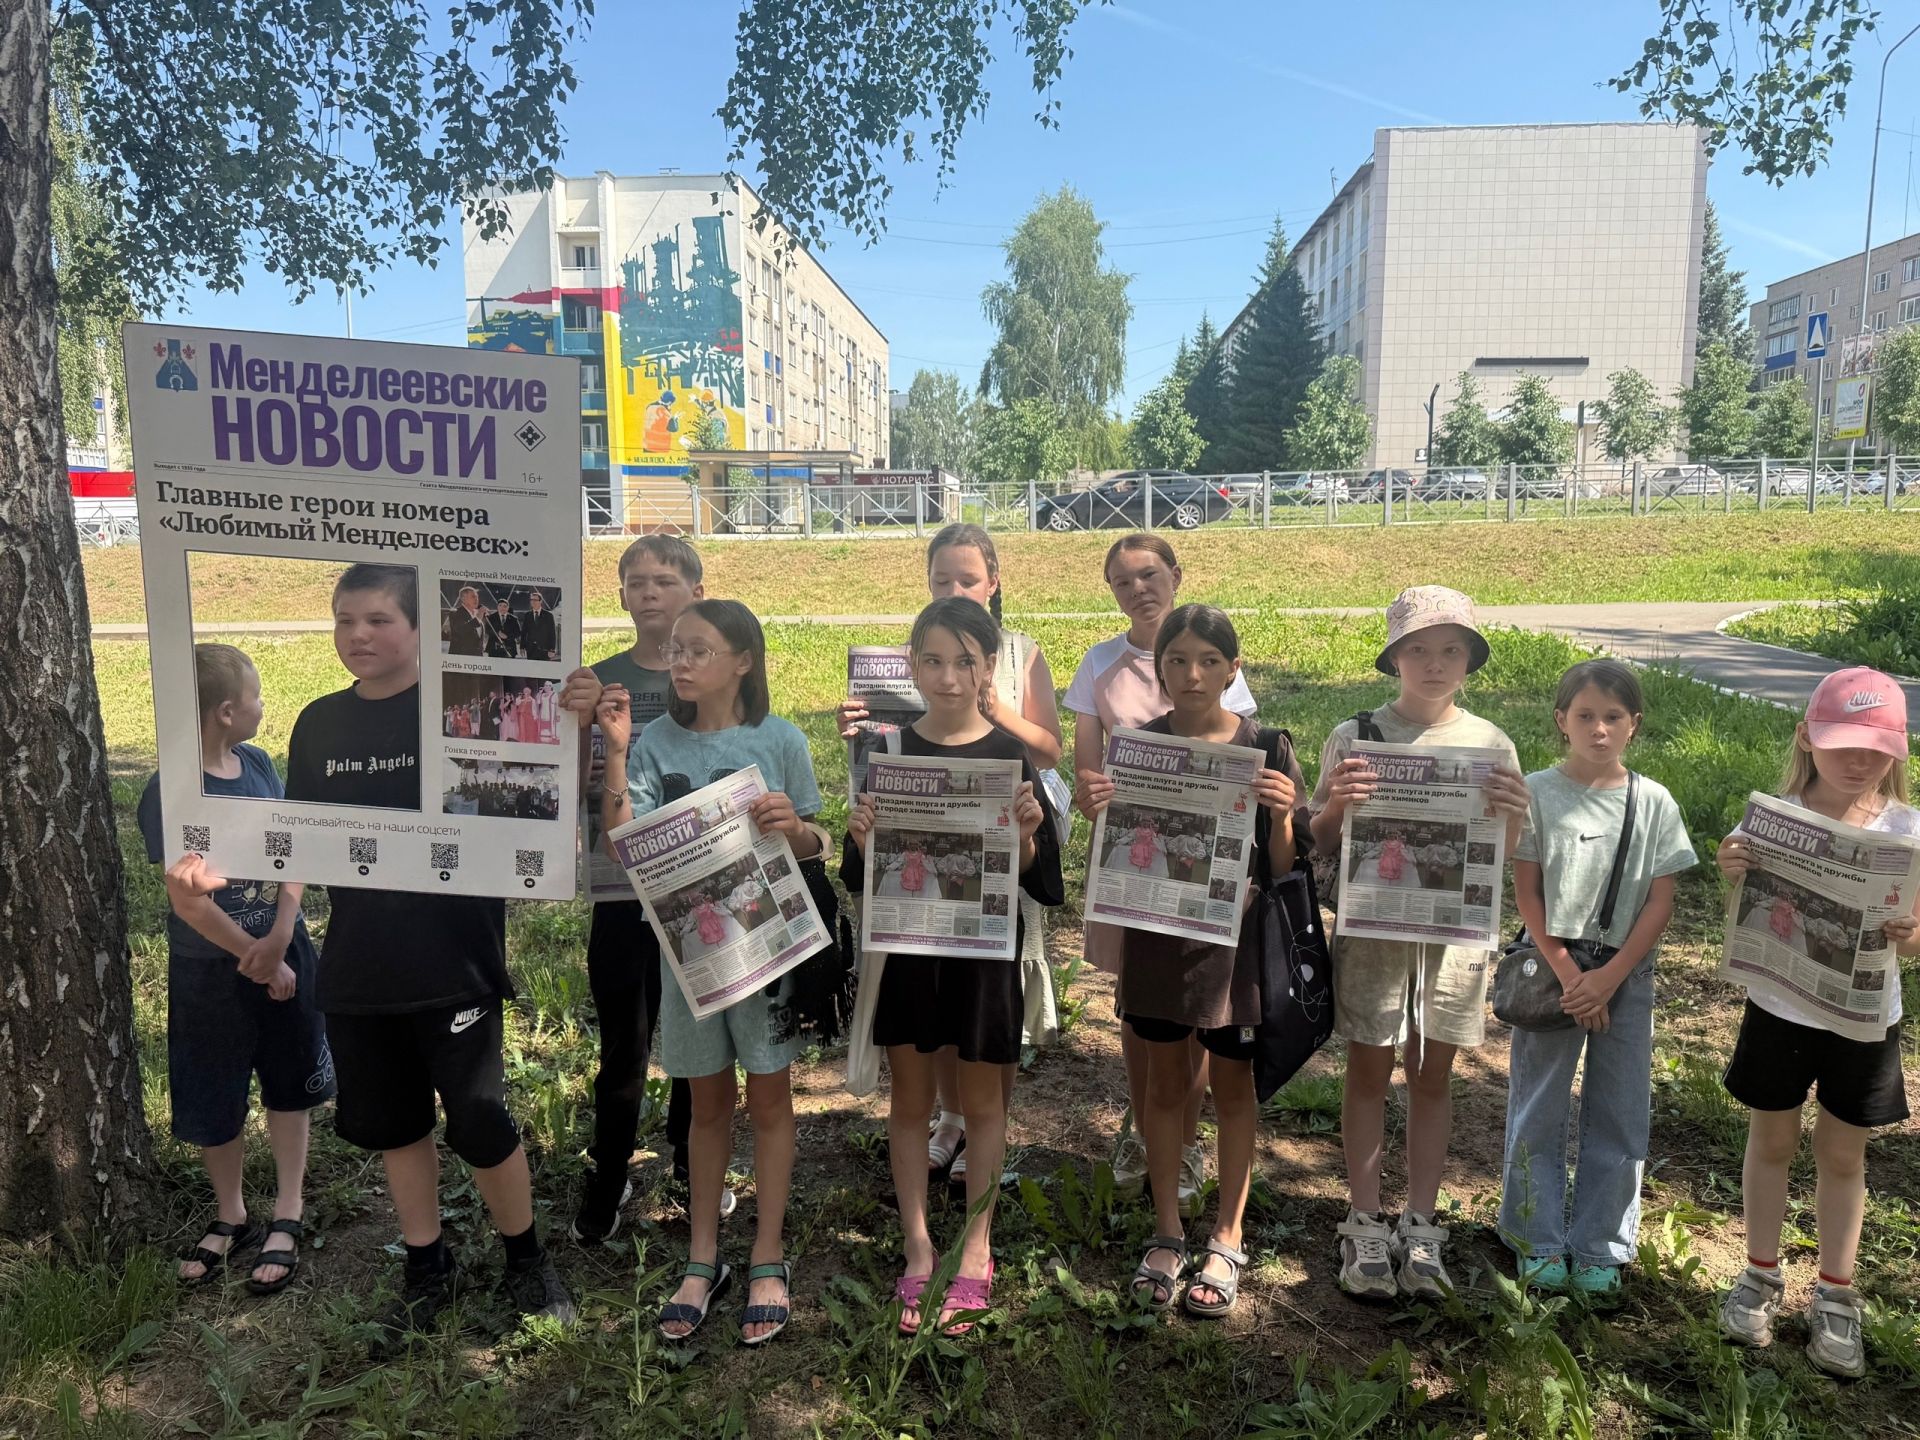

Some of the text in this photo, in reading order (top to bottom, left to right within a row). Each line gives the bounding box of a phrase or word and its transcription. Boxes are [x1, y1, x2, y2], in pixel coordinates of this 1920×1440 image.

[209, 342, 547, 413] Менделеевские
[212, 395, 497, 480] НОВОСТИ
[521, 472, 544, 485] 16+
[882, 476, 935, 484] НОТАРИУС
[156, 480, 490, 529] Главные герои номера
[159, 510, 529, 557] «Любимый Менделеевск»:
[438, 568, 556, 584] Атмосферный Менделеевск
[441, 661, 492, 672] День города
[853, 663, 906, 677] НОВОСТИ
[855, 656, 906, 665] Менделеевск
[1852, 691, 1884, 705] NIKE
[444, 746, 497, 757] Гонка героев
[1119, 739, 1188, 757] Менделеевские
[326, 753, 415, 777] Palm Angels
[1115, 747, 1180, 771] НОВОСТИ
[876, 765, 946, 779] Менделеевские
[1112, 769, 1153, 782] Праздник
[1153, 776, 1177, 787] плуга
[1184, 781, 1219, 792] дружбы
[874, 775, 939, 794] НОВОСТИ
[1117, 779, 1146, 788] городе
[1146, 783, 1183, 794] химиков
[1398, 788, 1423, 796] плуга
[1430, 790, 1467, 798] дружбы
[874, 796, 915, 806] Праздник
[915, 800, 939, 808] плуга
[946, 800, 981, 809] дружбы
[1391, 796, 1429, 804] химиков
[880, 805, 909, 813] городе
[909, 808, 946, 816] химиков
[271, 813, 461, 837] Подписывайтесь на наши соцсети
[625, 810, 696, 847] Менделеевские
[1753, 806, 1829, 840] Менделеевские
[627, 821, 695, 863] НОВОСТИ
[1748, 815, 1819, 853] НОВОСТИ
[636, 855, 679, 877] Праздник
[679, 842, 703, 859] плуга
[709, 823, 740, 846] дружбы
[646, 865, 676, 882] городе
[676, 848, 713, 869] химиков
[1783, 858, 1822, 878] химиков
[1789, 854, 1815, 867] плуга
[1823, 867, 1867, 884] дружбы
[455, 1007, 480, 1024] NIKE
